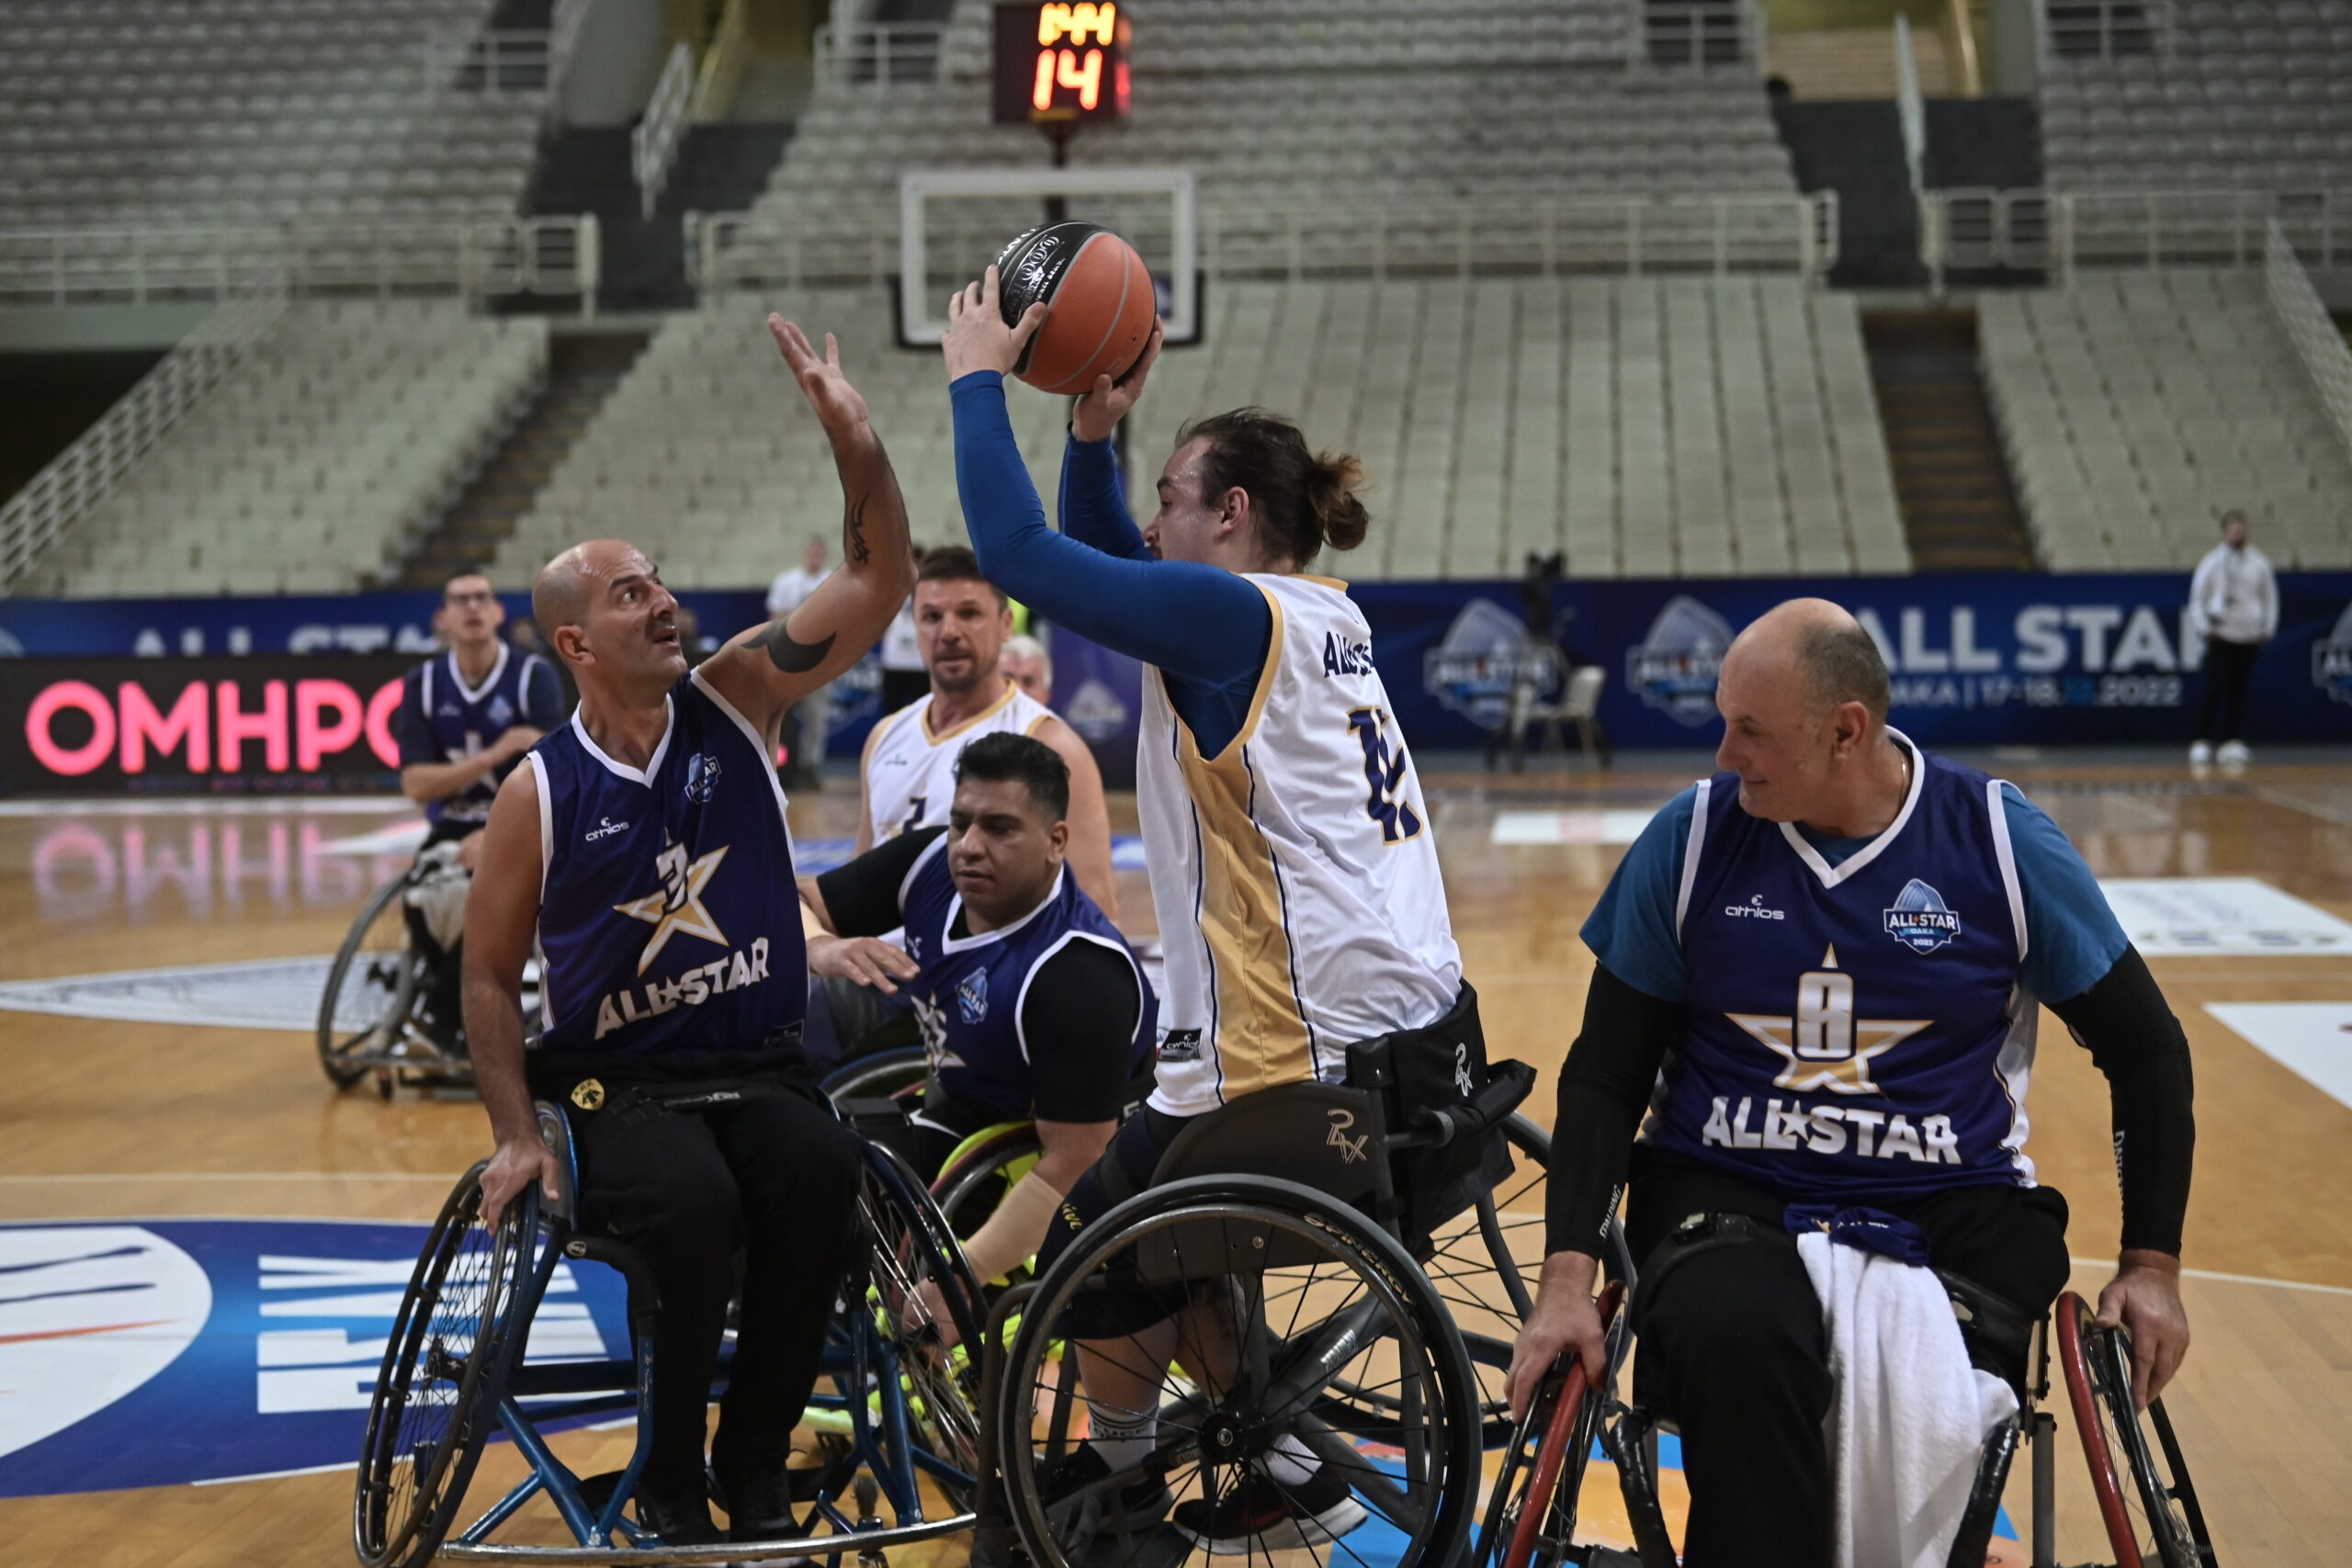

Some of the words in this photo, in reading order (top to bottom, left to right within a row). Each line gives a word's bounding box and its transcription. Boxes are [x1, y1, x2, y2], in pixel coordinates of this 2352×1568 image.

[1034, 49, 1102, 110] 14
[585, 821, 629, 842] athlos
[1725, 906, 1784, 920] athlos
[1889, 913, 1917, 929] ALL
[1918, 913, 1956, 931] STAR
[1913, 938, 1934, 947] 2022
[594, 982, 677, 1040] ALL
[679, 937, 770, 1006] STAR
[1796, 971, 1854, 1058] 8
[1702, 1096, 1798, 1150] ALL
[1806, 1105, 1962, 1165] STAR
[1599, 1183, 1622, 1242] SPALDING
